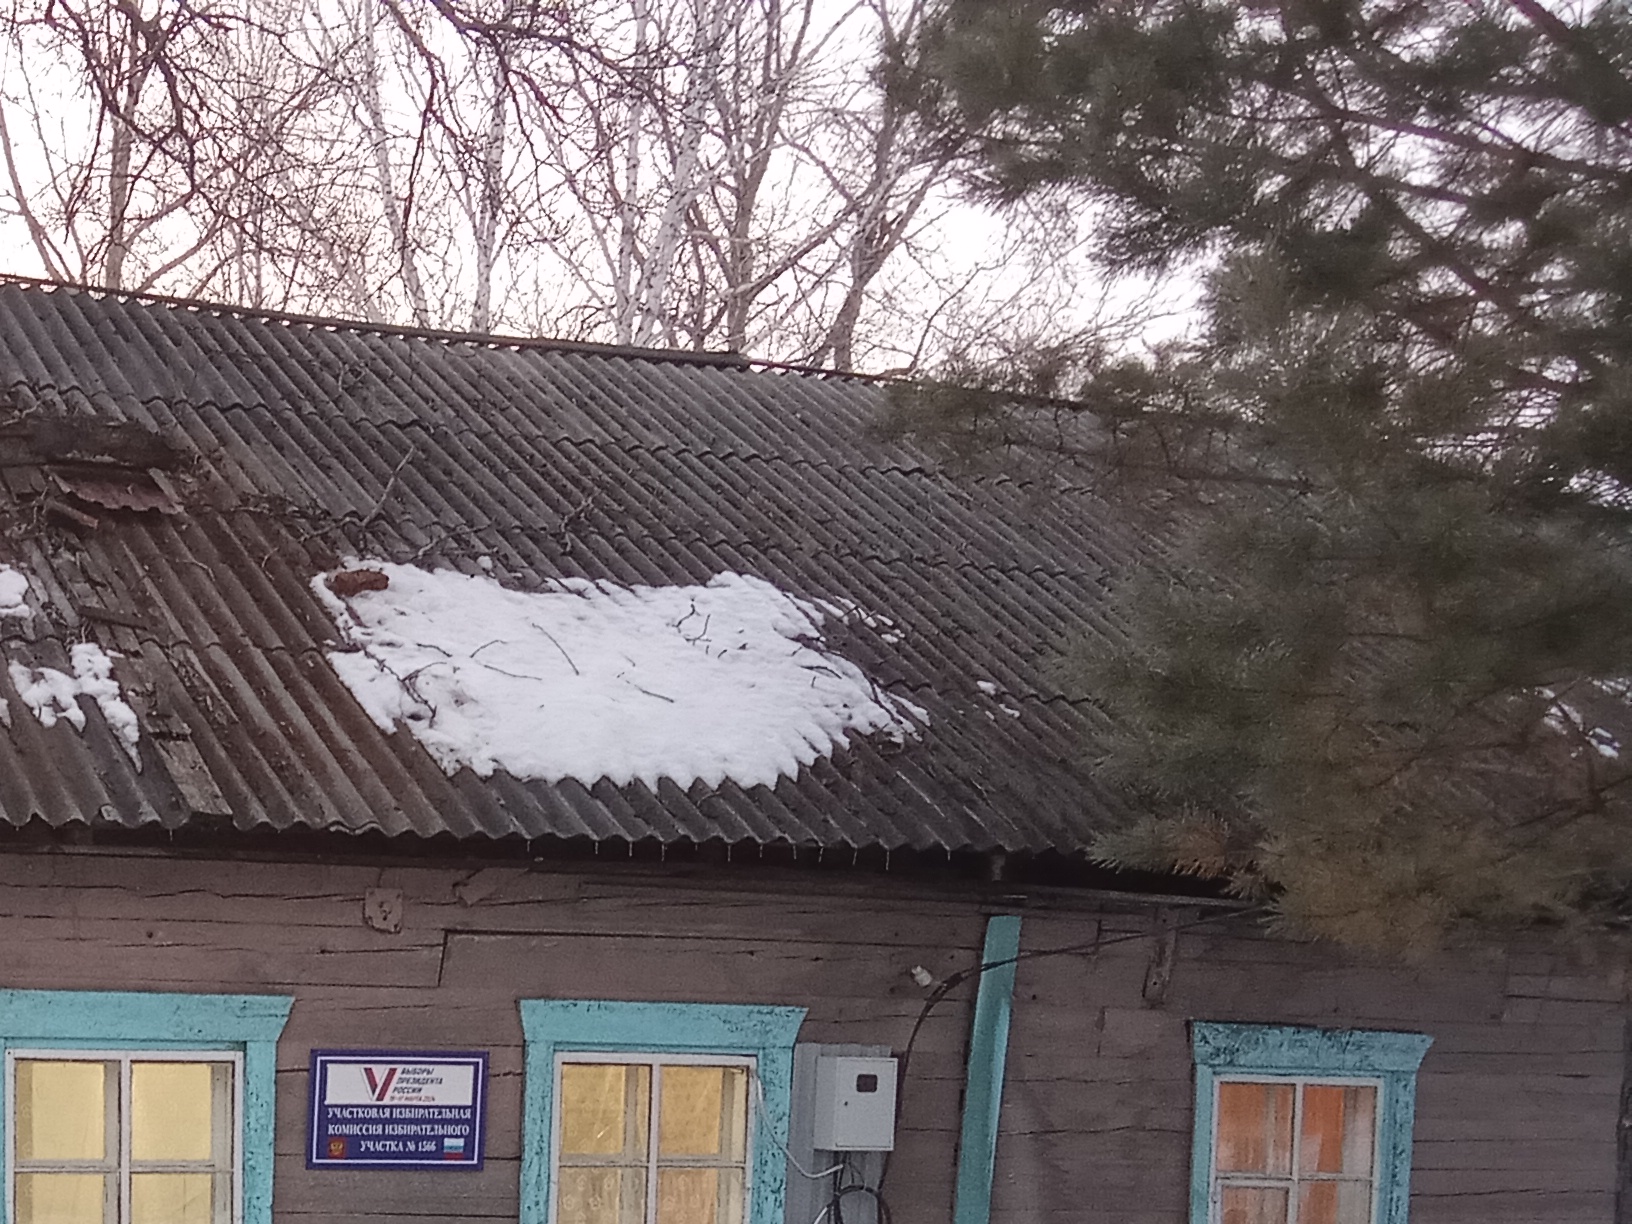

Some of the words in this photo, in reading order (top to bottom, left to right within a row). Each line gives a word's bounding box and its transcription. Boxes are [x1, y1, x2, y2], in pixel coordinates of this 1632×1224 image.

[328, 1108, 390, 1119] УЧАСТКОВАЯ
[393, 1108, 471, 1119] ИЗБИРАТЕЛЬНАЯ
[328, 1124, 383, 1135] КОМИССИЯ
[385, 1124, 469, 1135] ИЗБИРАТЕЛЬНОГО
[360, 1141, 403, 1152] УЧАСТКА
